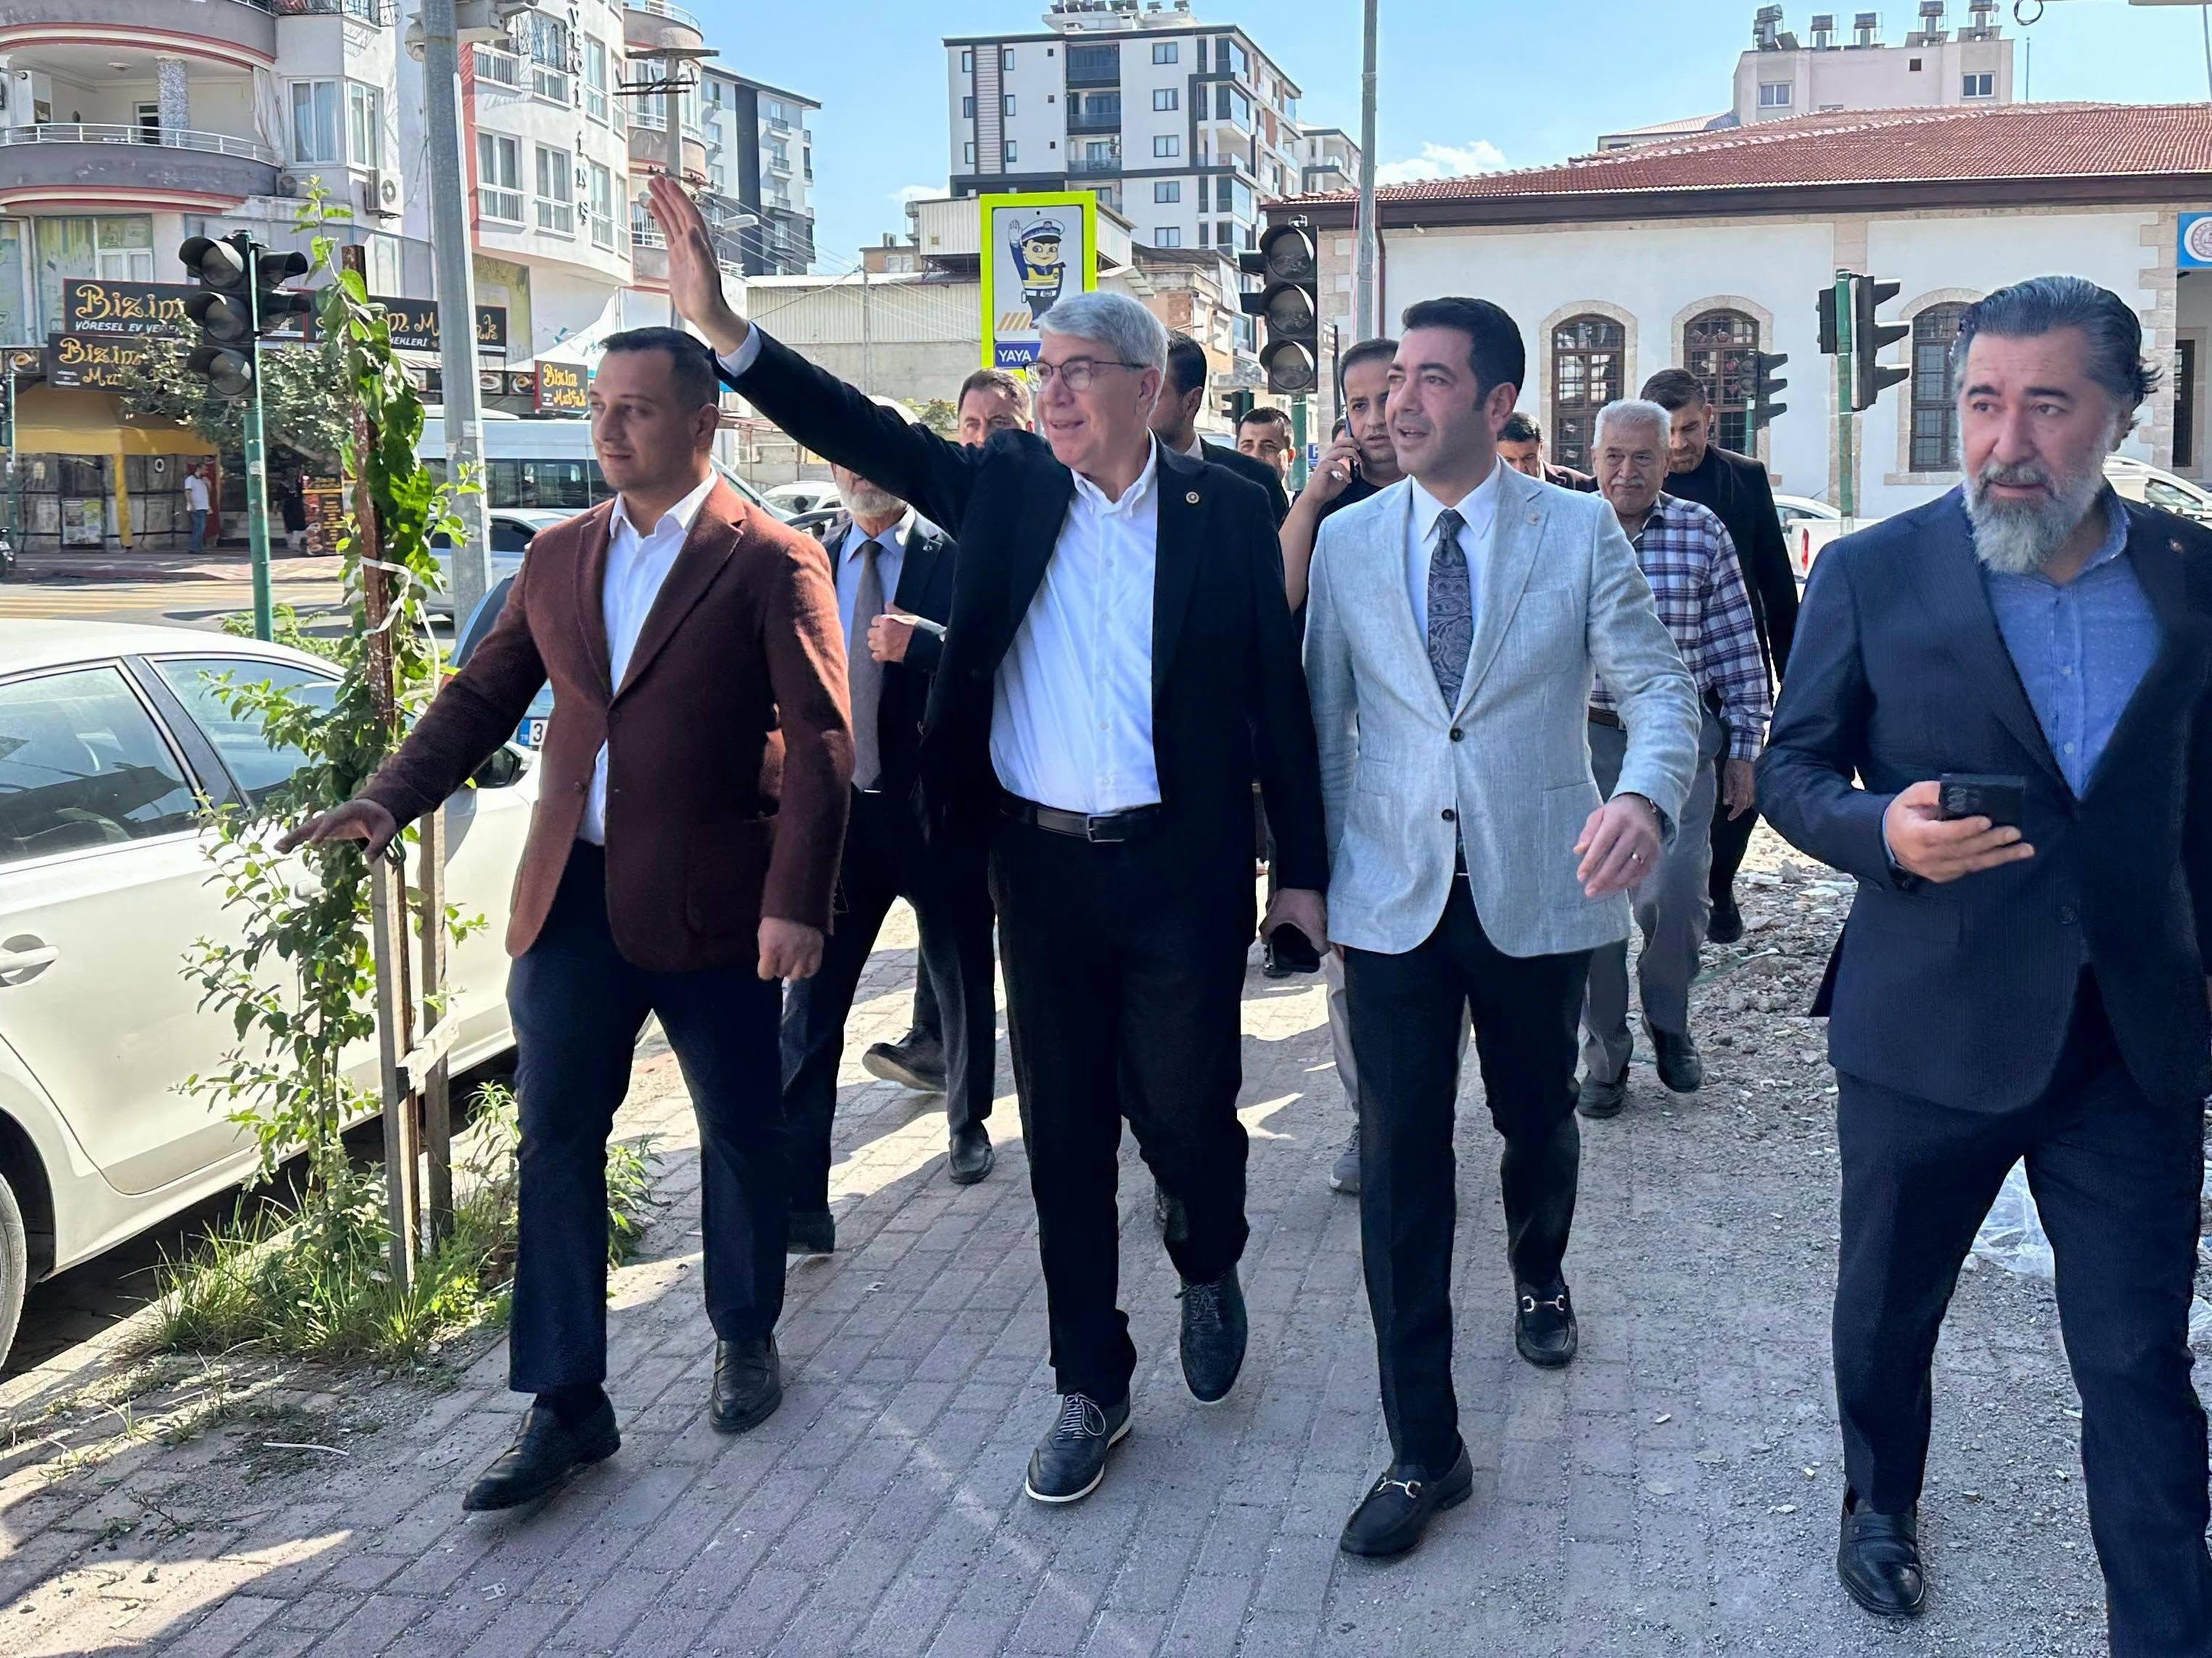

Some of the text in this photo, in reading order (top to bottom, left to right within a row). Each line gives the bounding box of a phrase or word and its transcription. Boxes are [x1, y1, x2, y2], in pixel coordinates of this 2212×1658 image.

[75, 320, 125, 332] YÖRESEL
[128, 323, 144, 333] EV
[59, 337, 141, 366] Bizim
[998, 349, 1032, 363] YAYA
